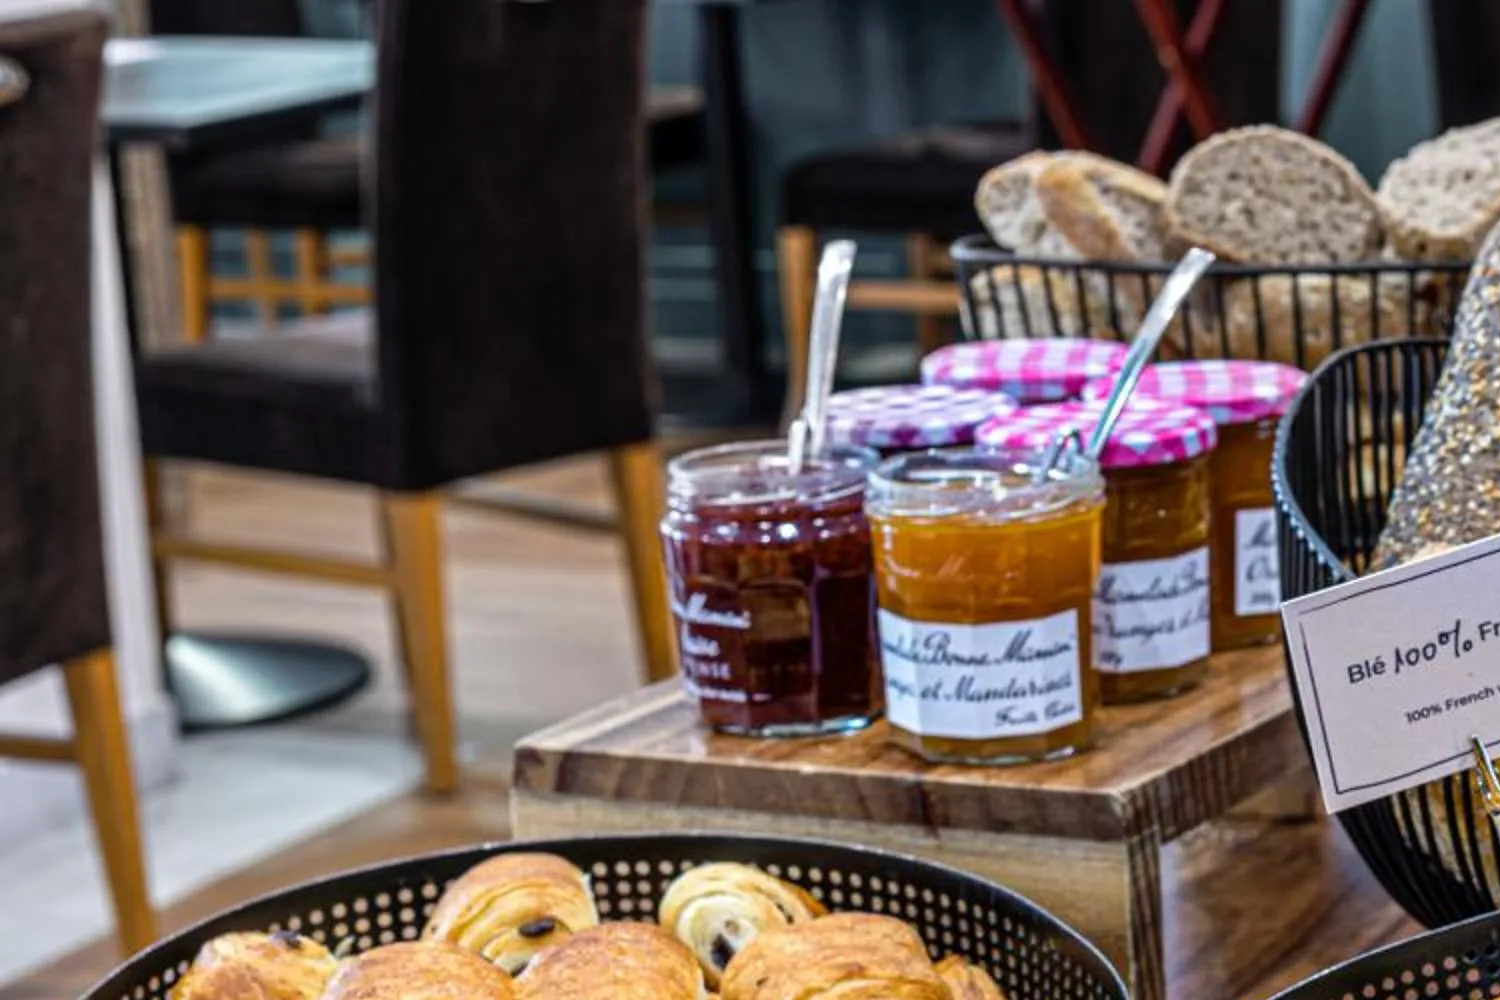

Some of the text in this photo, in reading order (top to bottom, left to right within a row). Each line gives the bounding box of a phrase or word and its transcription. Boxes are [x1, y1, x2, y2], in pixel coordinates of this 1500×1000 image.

[1347, 656, 1386, 684] Blé
[1394, 618, 1473, 674] 100%
[1405, 703, 1442, 724] 100%
[1445, 687, 1494, 710] French
